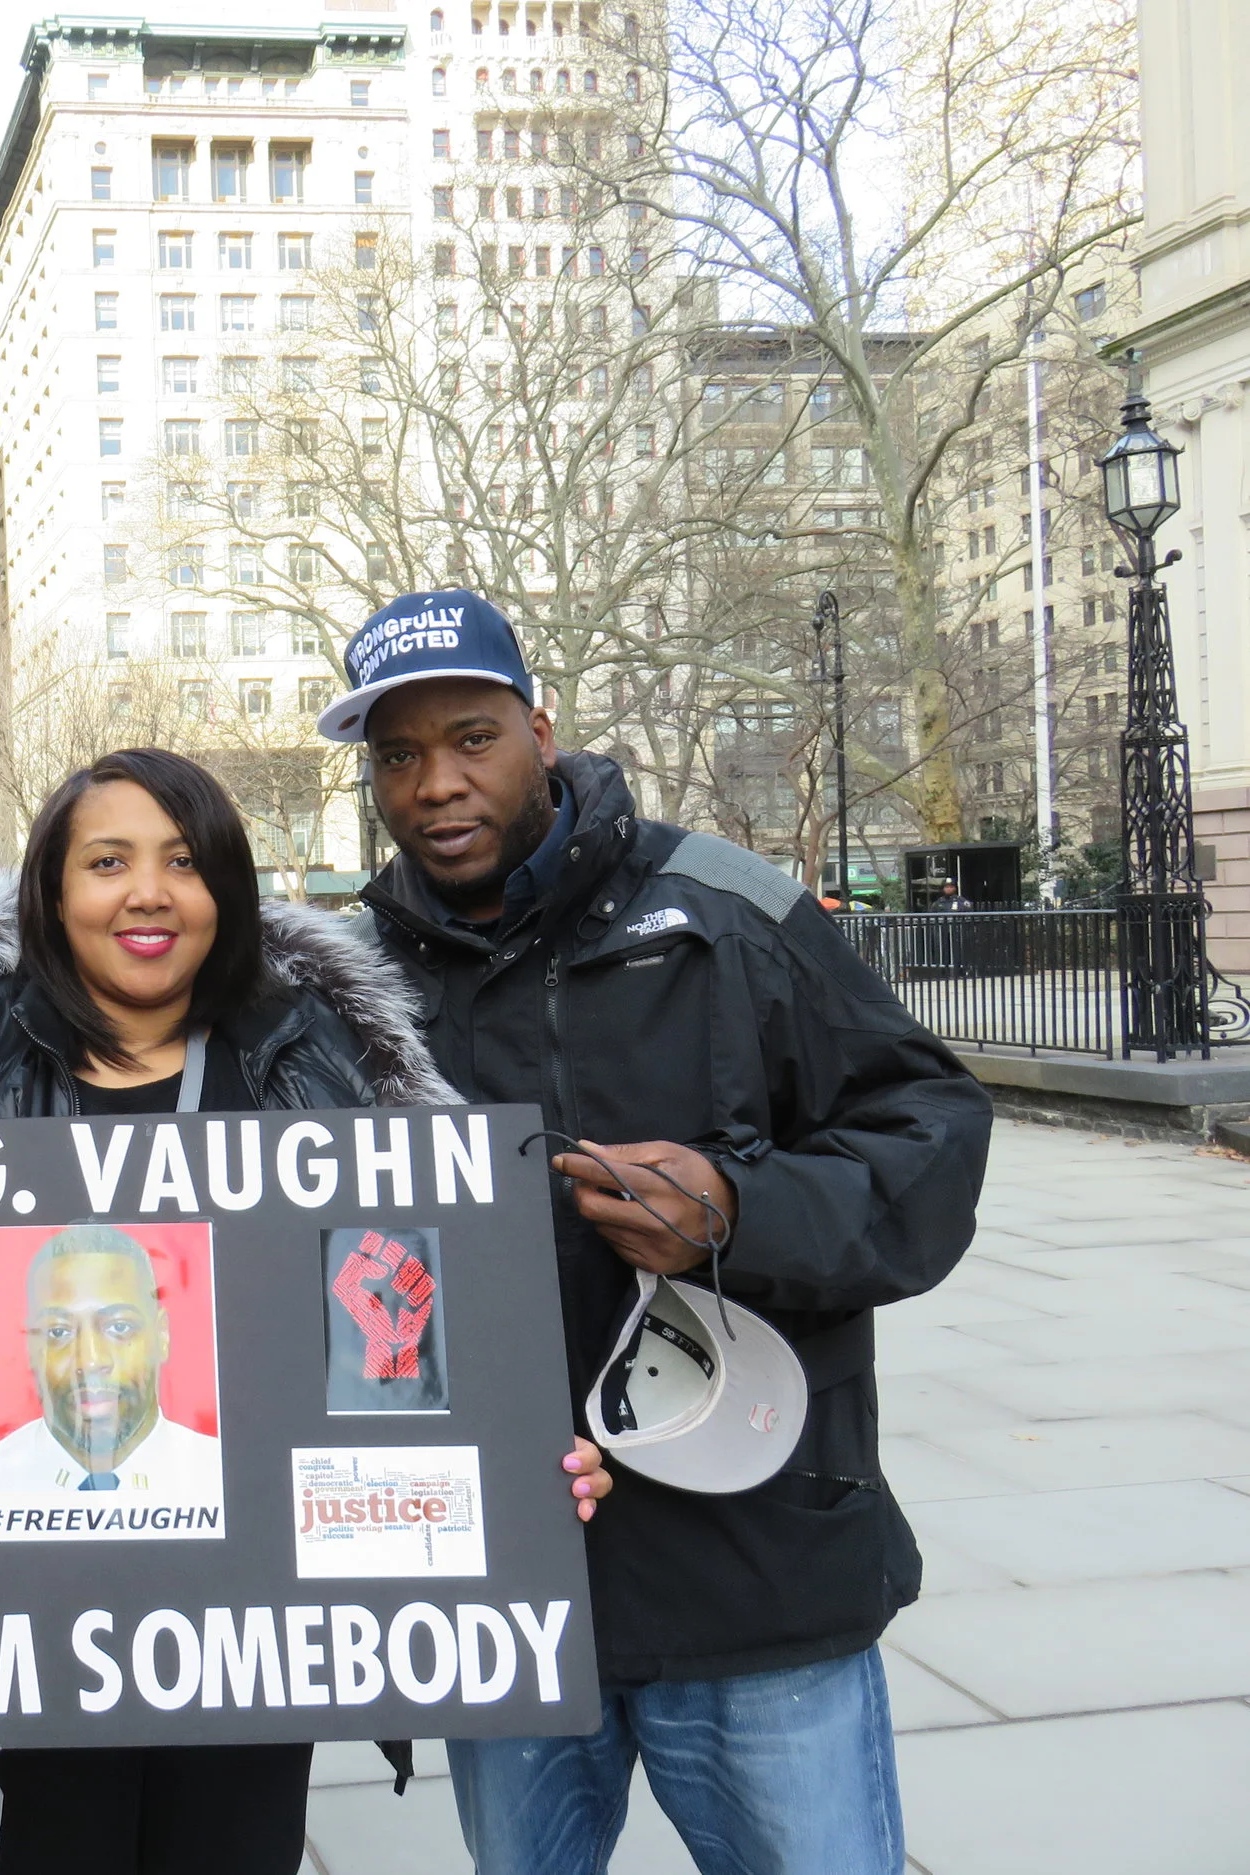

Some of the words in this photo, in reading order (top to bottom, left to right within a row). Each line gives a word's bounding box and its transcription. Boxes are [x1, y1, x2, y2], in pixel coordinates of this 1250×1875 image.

[348, 607, 465, 672] WRONGFULLY
[359, 630, 459, 688] CONVICTED
[642, 909, 666, 922] THE
[626, 915, 666, 934] NORTH
[639, 923, 667, 936] FACE
[70, 1113, 495, 1214] VAUGHN
[311, 1457, 331, 1465] chief
[298, 1464, 335, 1472] congress
[352, 1456, 360, 1483] power
[305, 1472, 334, 1481] capitol
[366, 1480, 399, 1488] election
[410, 1480, 450, 1488] campaign
[315, 1486, 365, 1494] government
[411, 1488, 454, 1497] legislation
[300, 1487, 447, 1534] justice
[328, 1525, 355, 1534] politic
[356, 1525, 383, 1533] voting
[437, 1524, 472, 1533] patriotic
[425, 1524, 433, 1567] candidate
[71, 1599, 571, 1714] SOMEBODY
